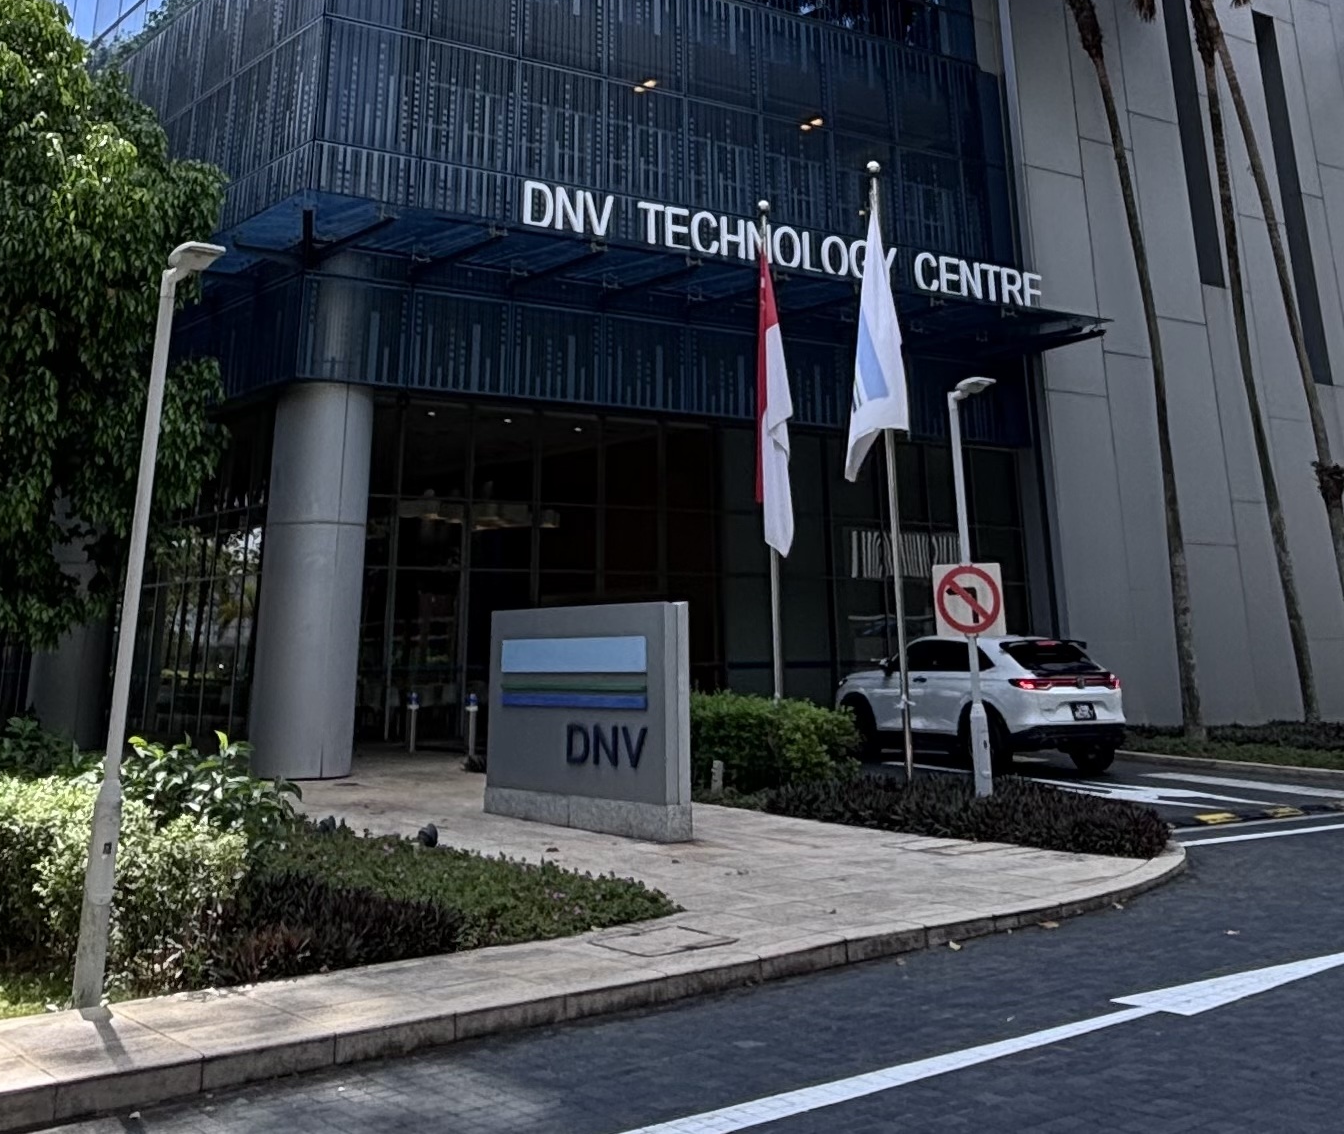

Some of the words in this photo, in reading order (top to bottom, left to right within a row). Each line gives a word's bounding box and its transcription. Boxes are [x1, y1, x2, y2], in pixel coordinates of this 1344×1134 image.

[523, 180, 614, 236] DNV
[914, 252, 1042, 306] CENTRE
[566, 723, 648, 769] DNV
